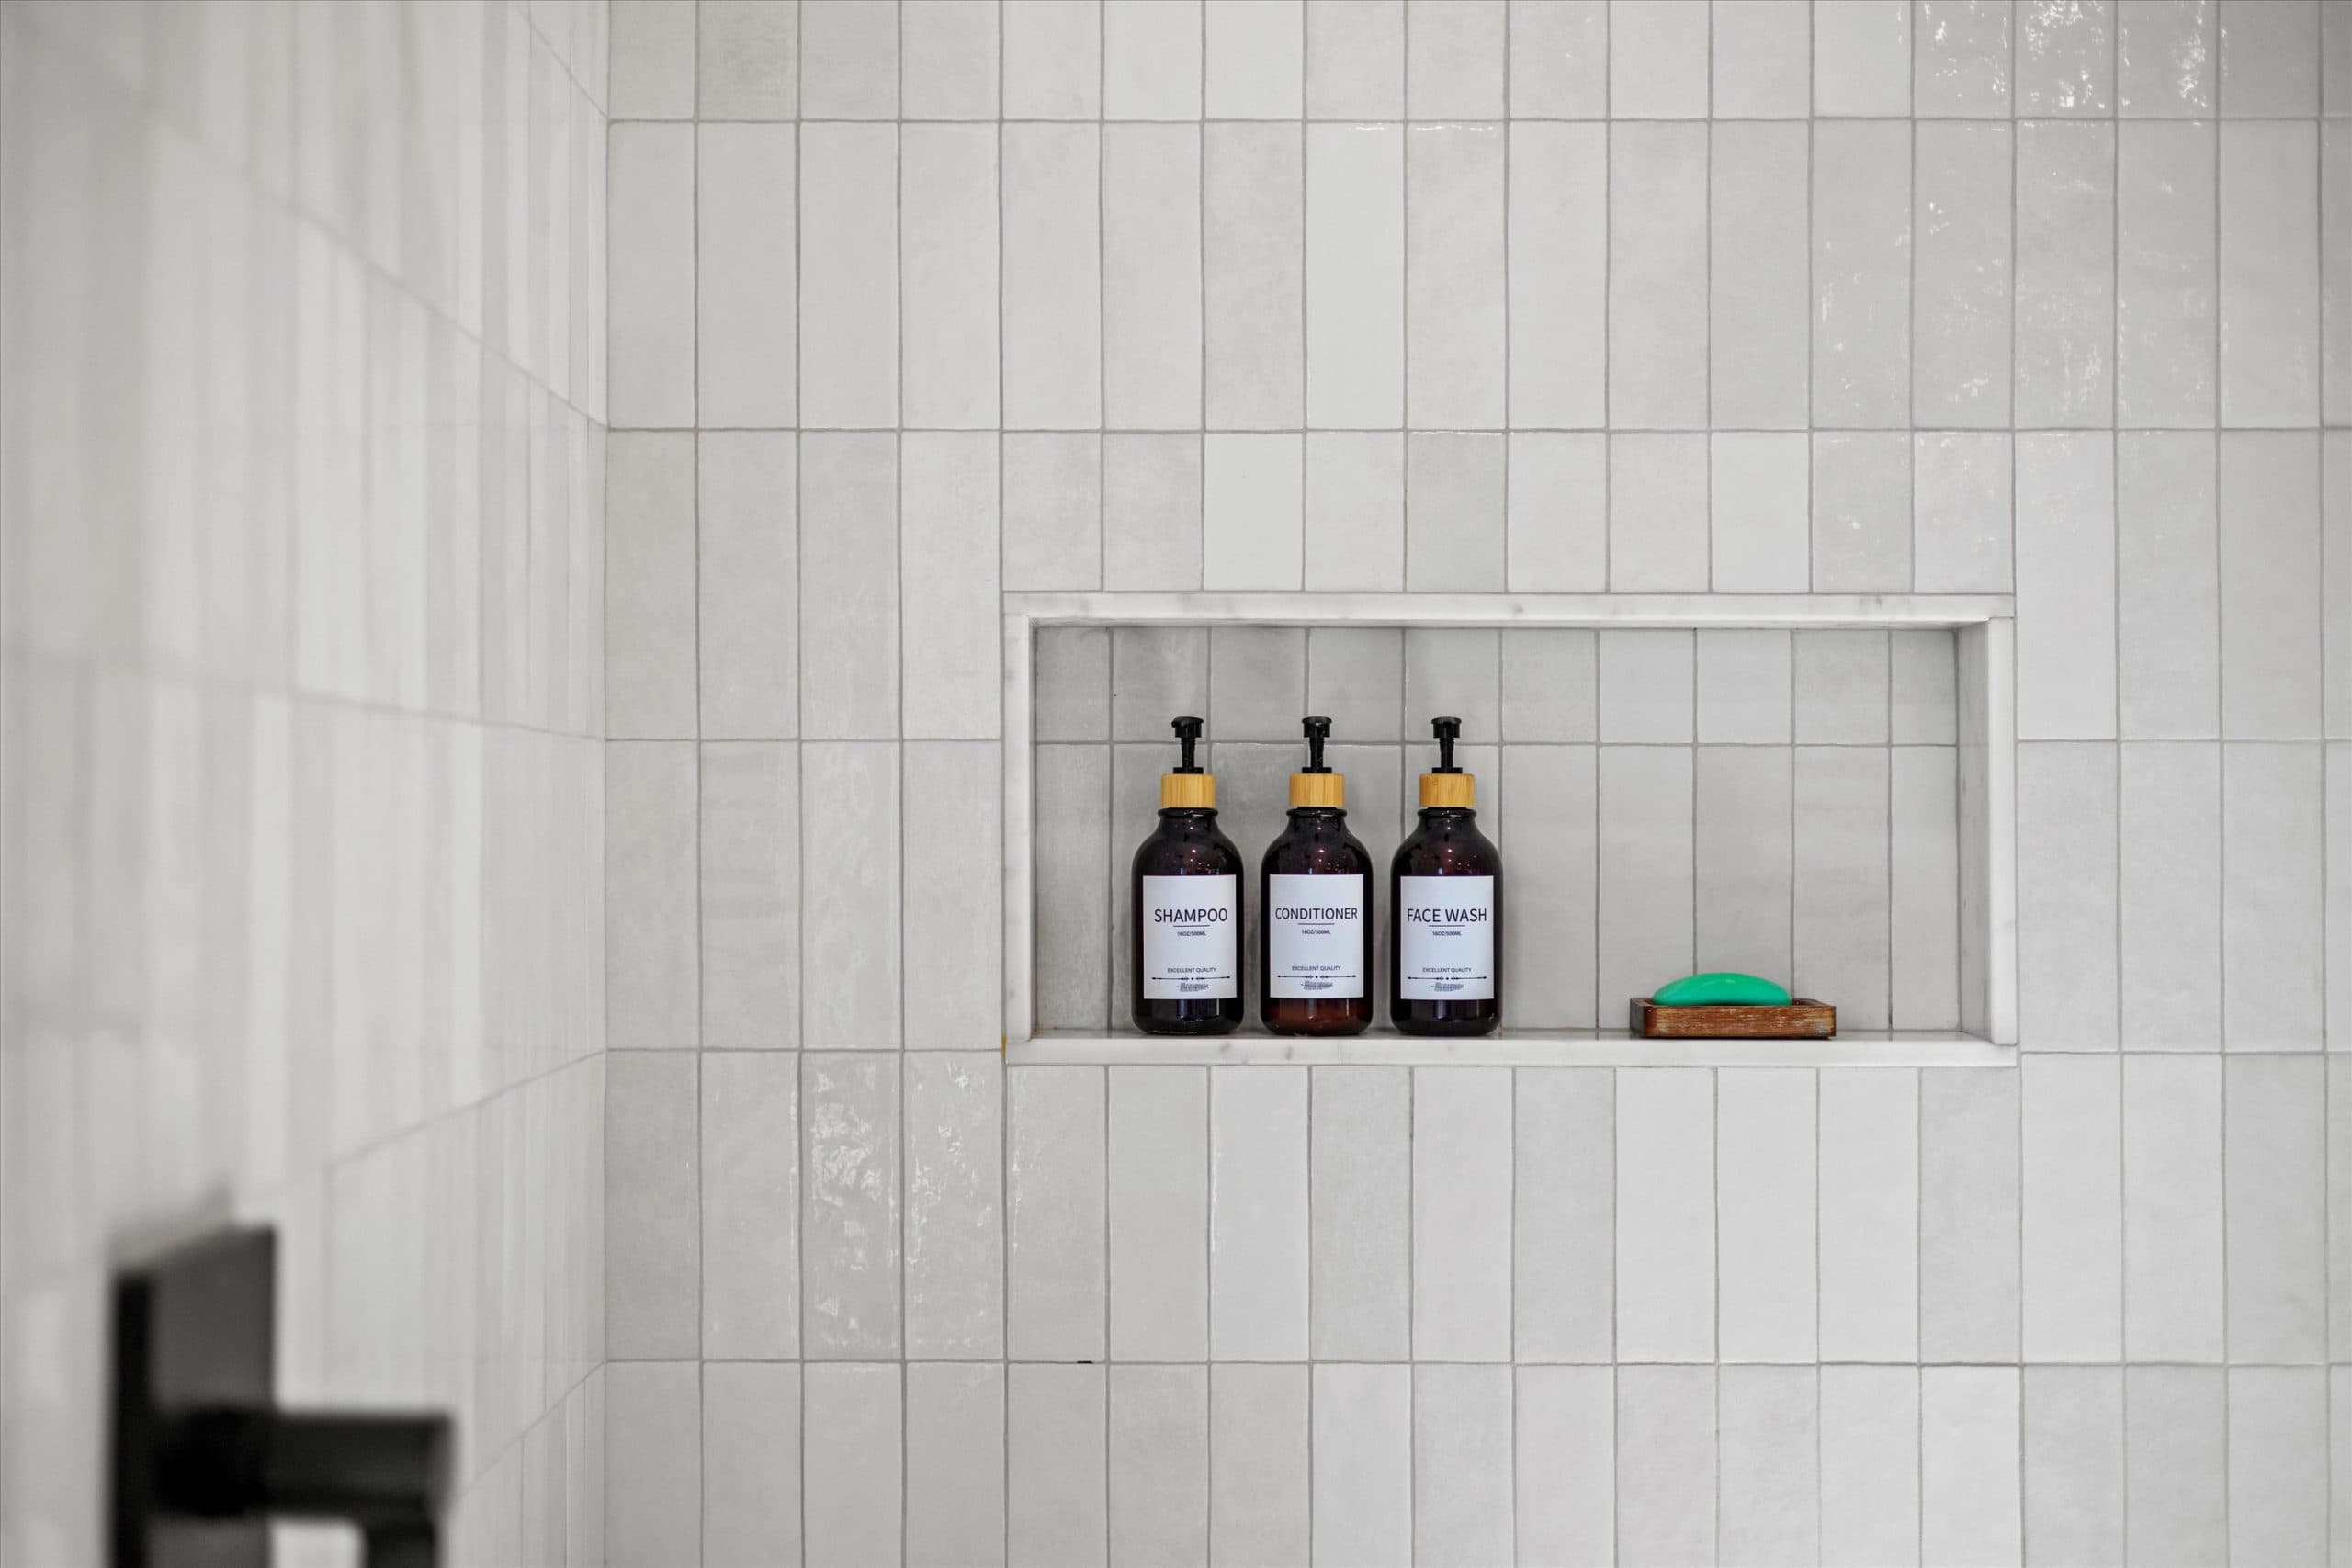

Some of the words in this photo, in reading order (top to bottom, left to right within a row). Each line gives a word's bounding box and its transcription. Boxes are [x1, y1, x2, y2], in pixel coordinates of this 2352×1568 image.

[1154, 908, 1228, 923] SHAMPOO
[1275, 908, 1358, 920] CONDITIONER
[1408, 908, 1442, 923] FACE
[1445, 908, 1487, 923] WASH
